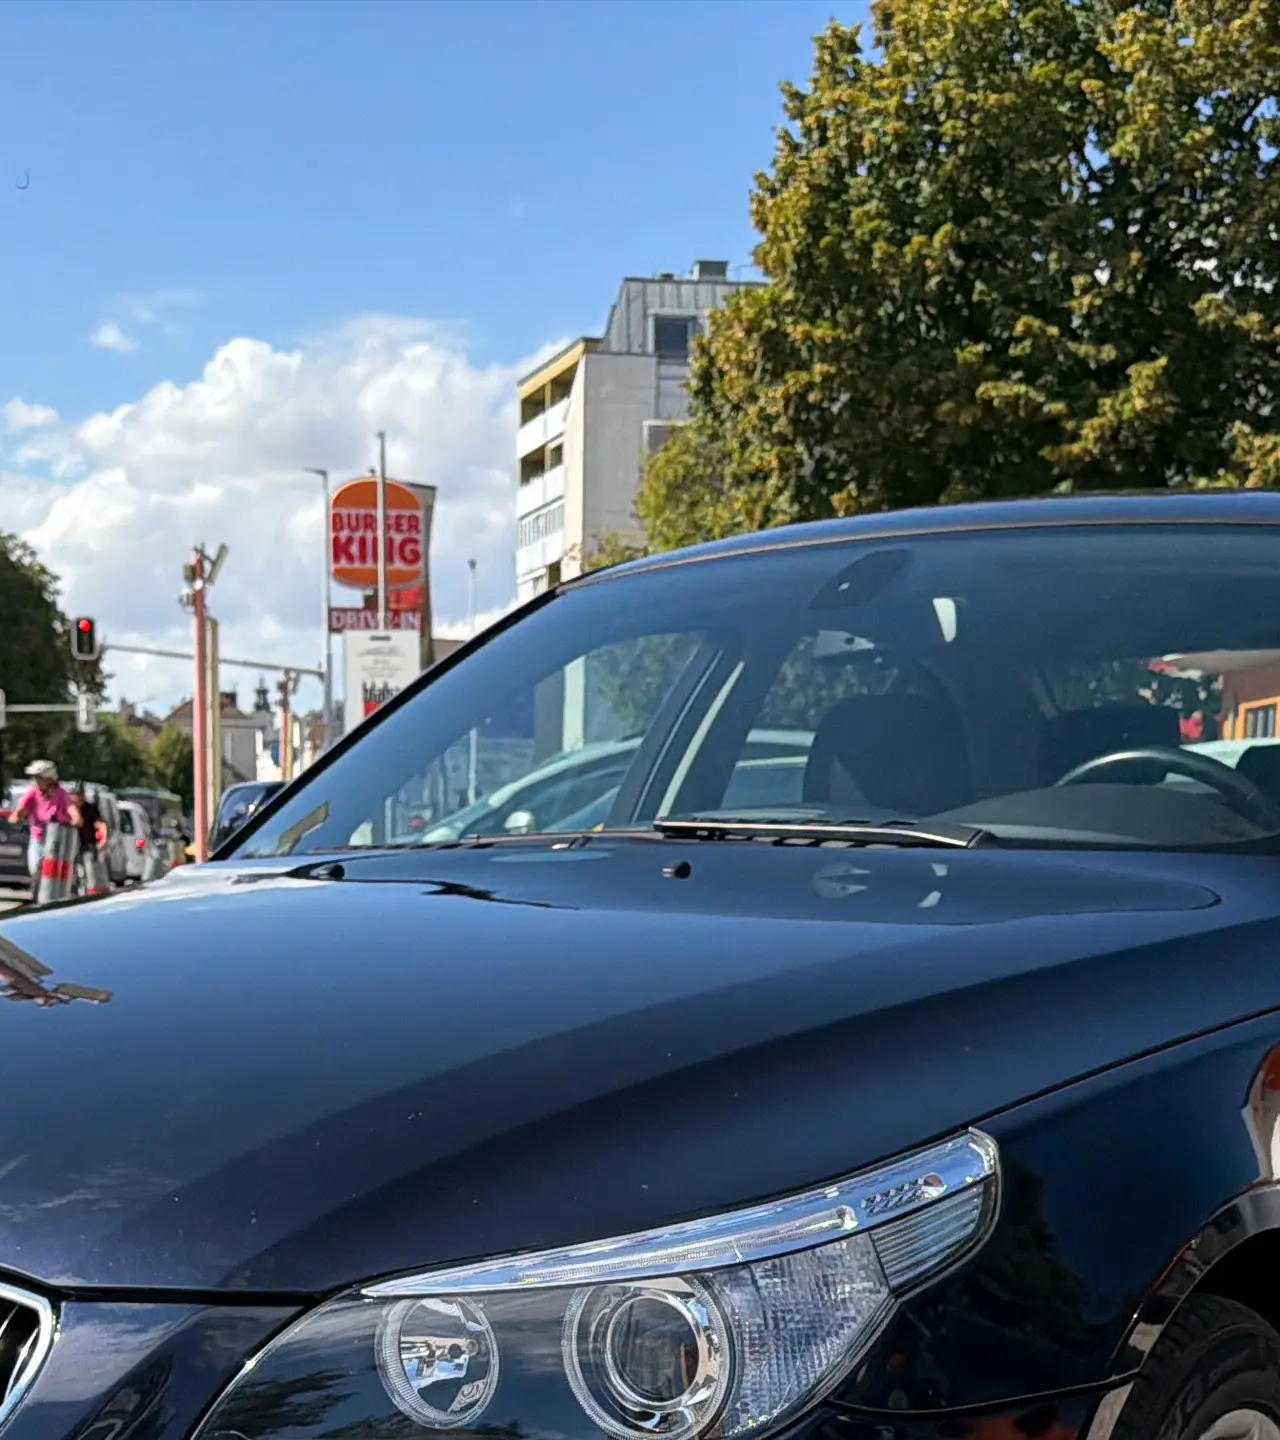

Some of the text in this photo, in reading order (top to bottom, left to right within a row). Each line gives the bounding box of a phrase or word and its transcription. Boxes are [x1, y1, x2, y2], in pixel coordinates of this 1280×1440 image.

[332, 512, 422, 534] BURER
[332, 535, 422, 566] KING
[331, 609, 421, 630] DRIV-IN
